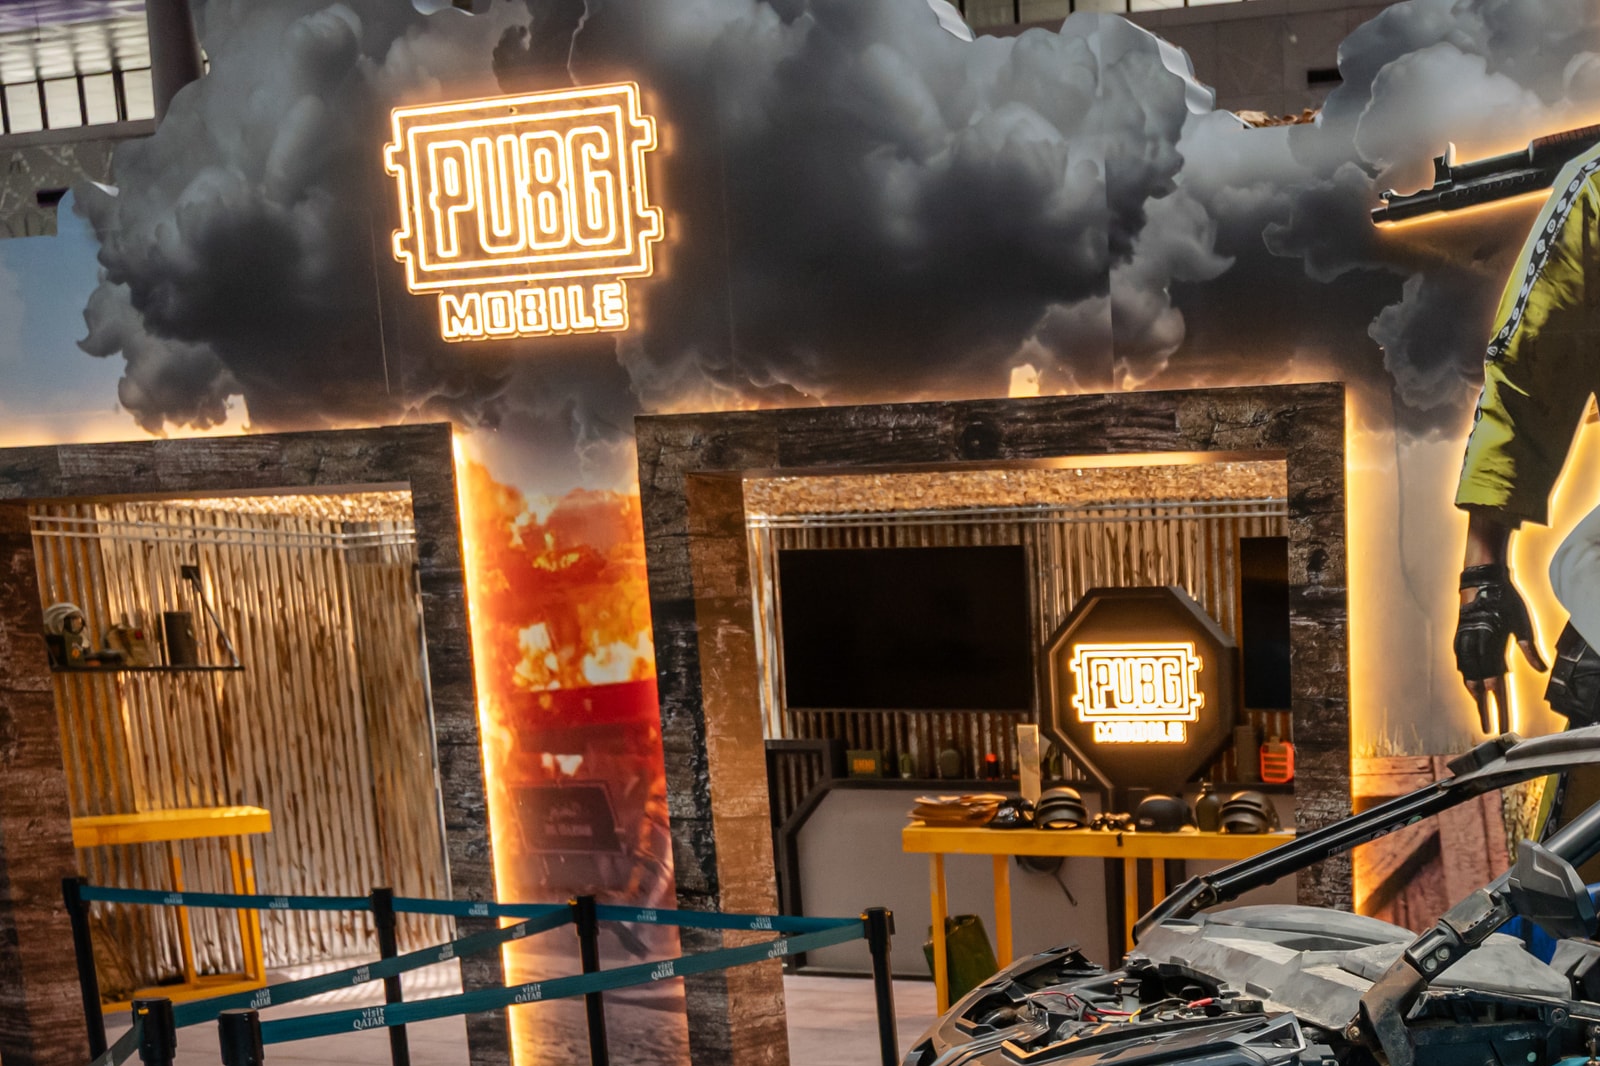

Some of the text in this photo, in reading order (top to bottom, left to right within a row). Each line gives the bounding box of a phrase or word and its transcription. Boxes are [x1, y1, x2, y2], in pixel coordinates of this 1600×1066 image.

[428, 126, 617, 257] PUBG
[439, 280, 628, 341] MOBILE
[1090, 657, 1182, 710] PUBG
[751, 921, 772, 929] QATAR
[768, 947, 788, 958] QATAR
[657, 962, 674, 970] visit
[651, 968, 674, 980] QATAR
[522, 984, 541, 994] visit
[250, 996, 271, 1009] QATAR
[515, 991, 542, 1003] QATAR
[362, 1007, 385, 1018] visit
[353, 1016, 385, 1030] QATAR
